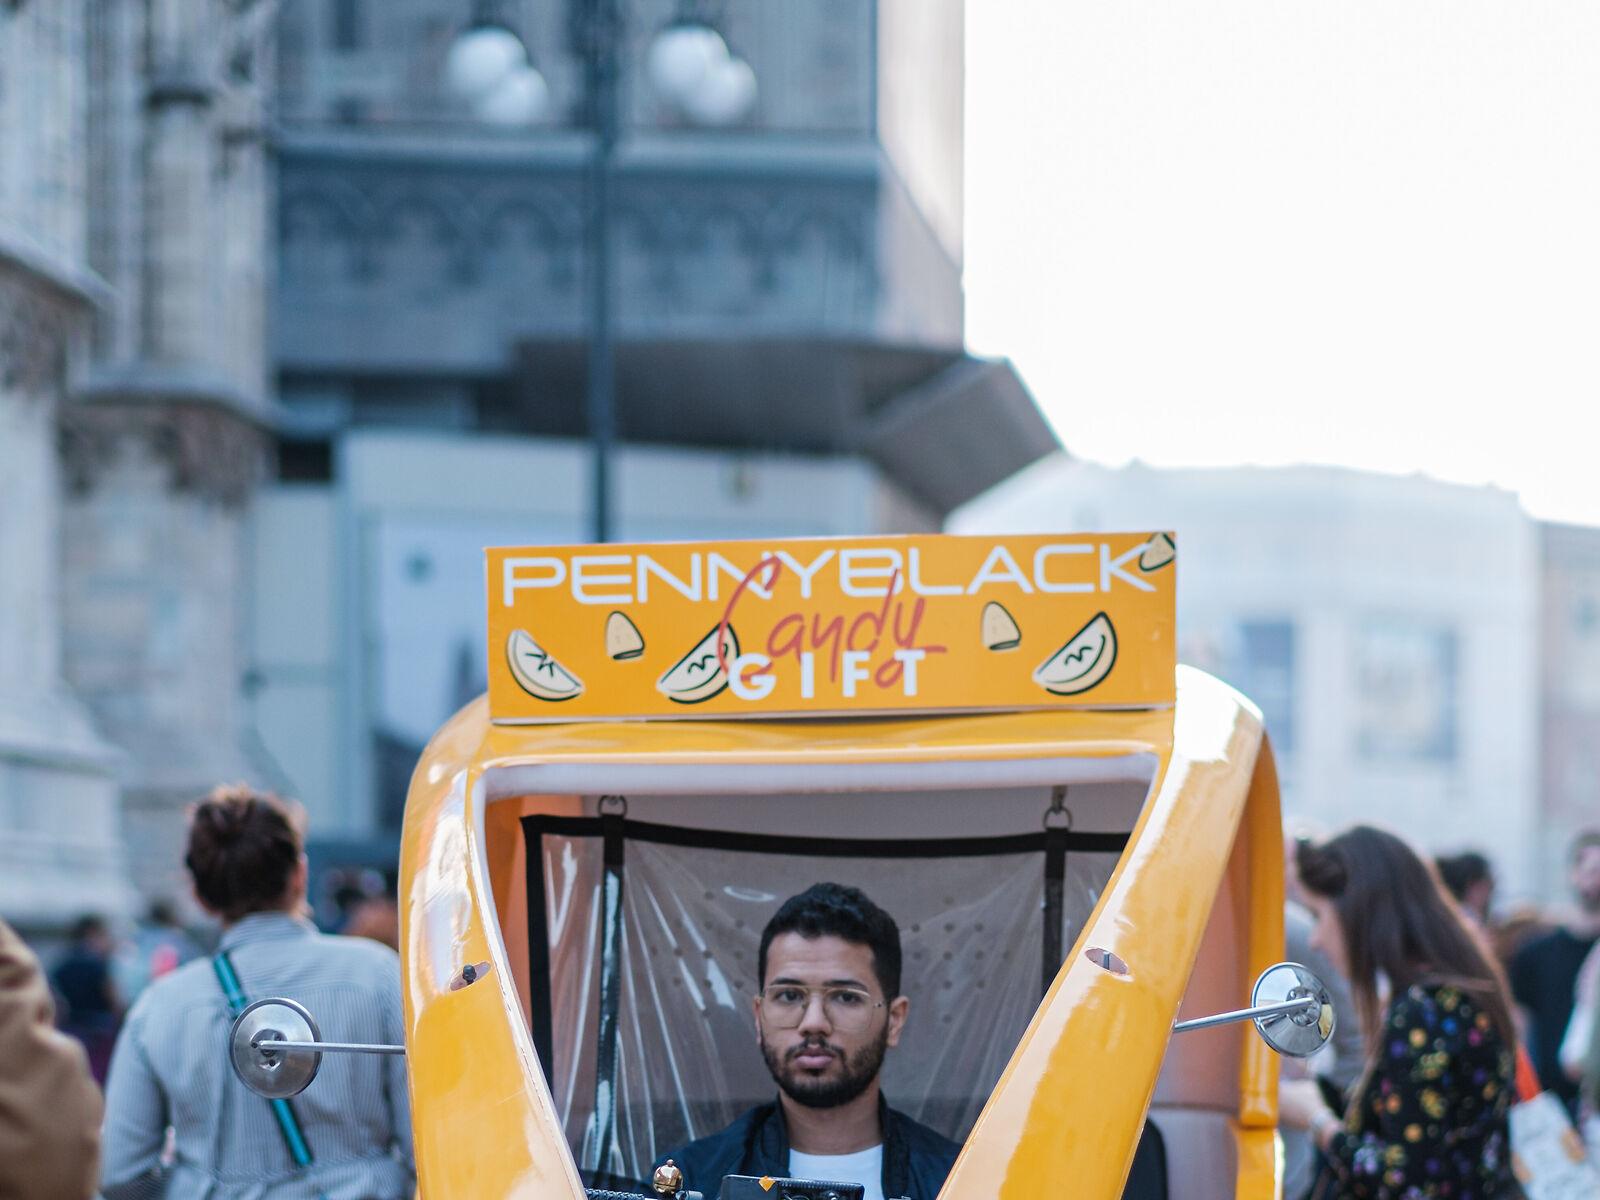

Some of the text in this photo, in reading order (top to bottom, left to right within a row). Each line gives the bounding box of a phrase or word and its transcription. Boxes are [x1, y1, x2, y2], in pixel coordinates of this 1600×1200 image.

[502, 543, 1157, 607] PENNYBLACK
[717, 555, 948, 689] Candy
[728, 648, 926, 701] GIFT
